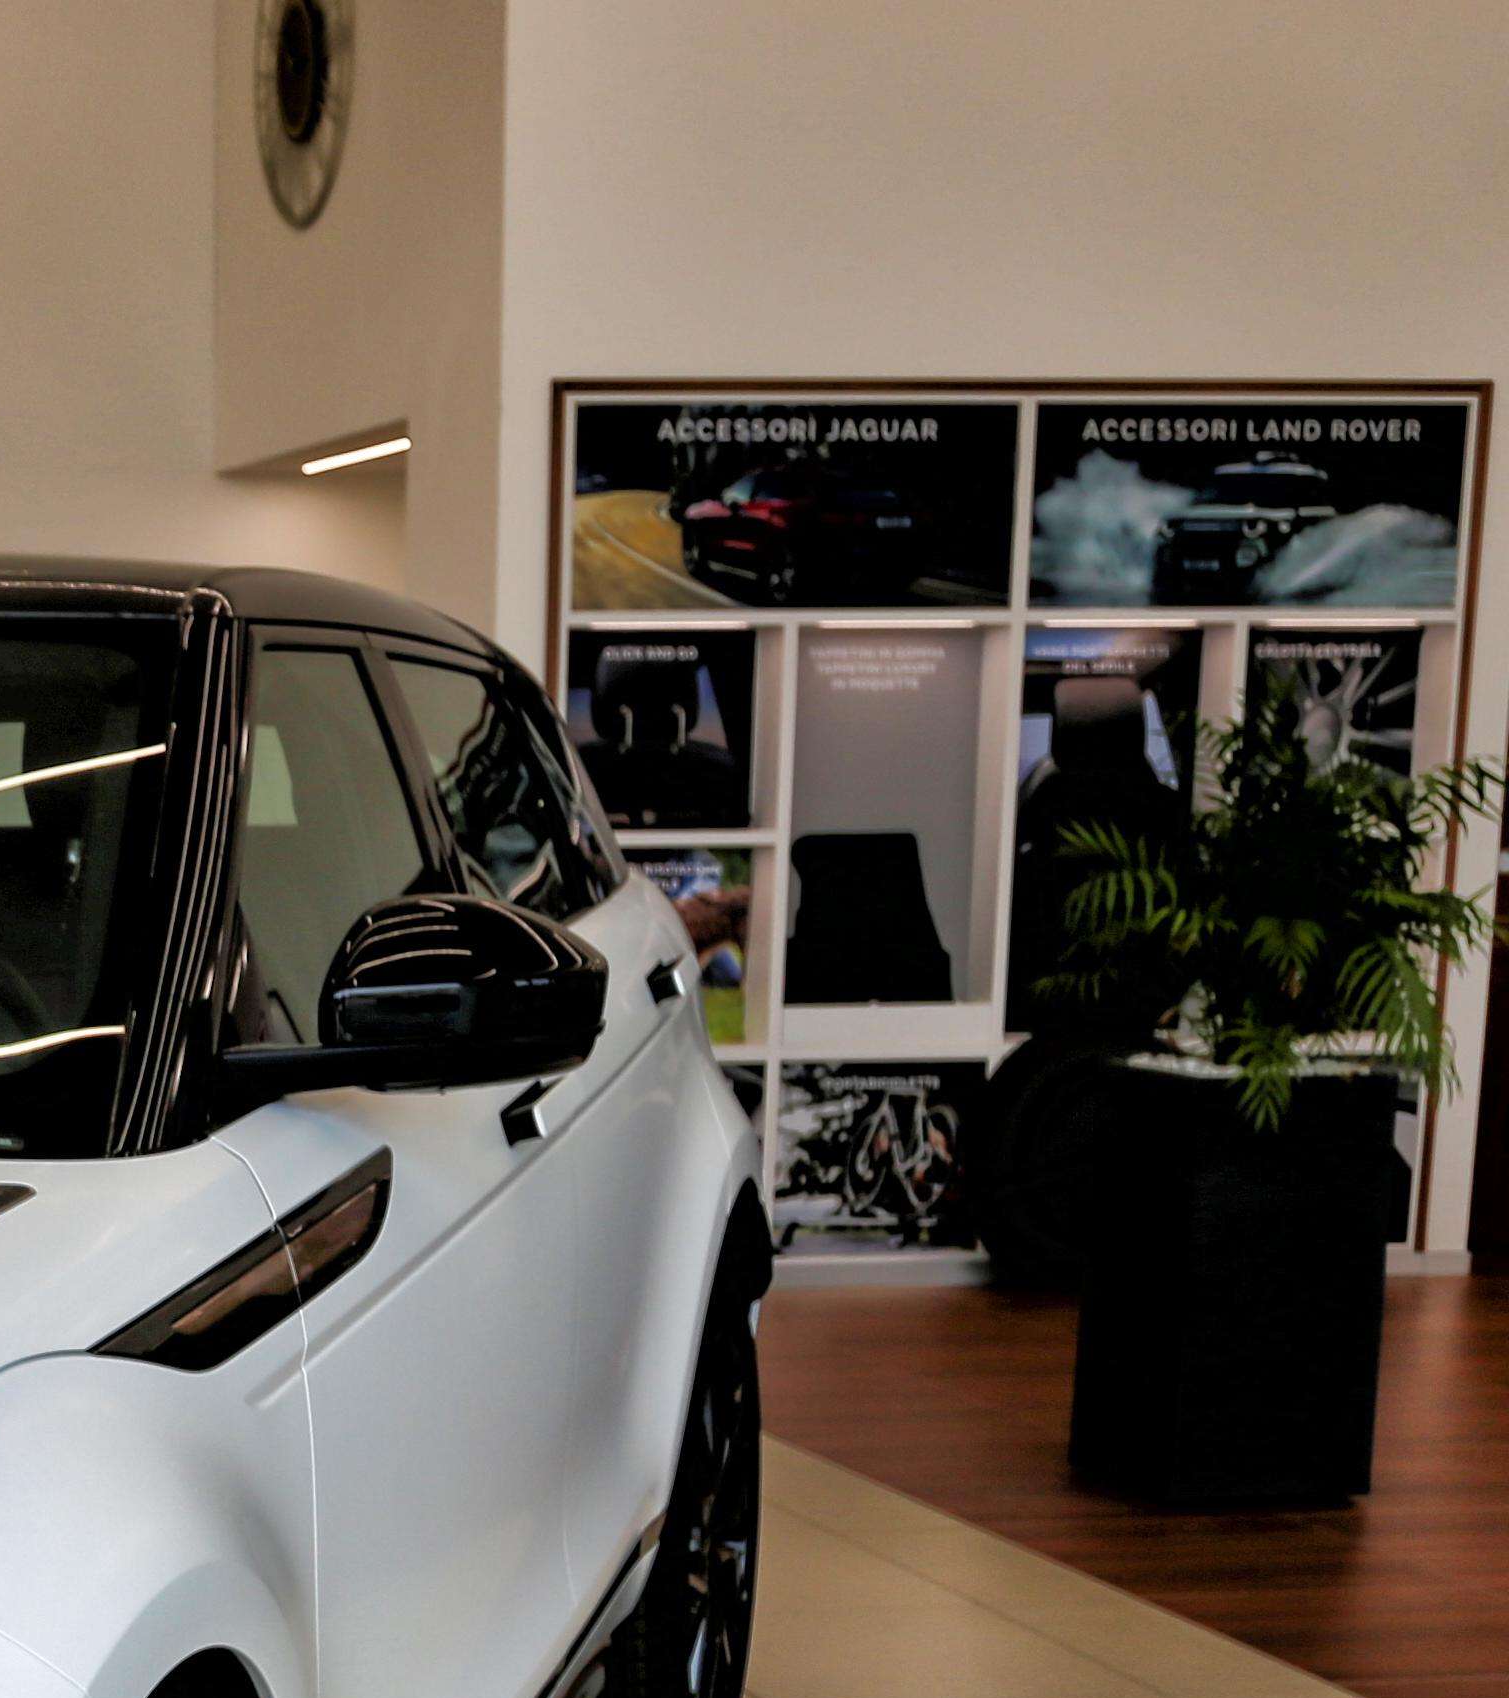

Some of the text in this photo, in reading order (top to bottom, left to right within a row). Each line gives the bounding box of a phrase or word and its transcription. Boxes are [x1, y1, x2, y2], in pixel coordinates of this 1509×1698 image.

[658, 417, 939, 443] ACCESSORI JAGUAR
[1081, 417, 1422, 442] ACCESSORI LAND ROVER
